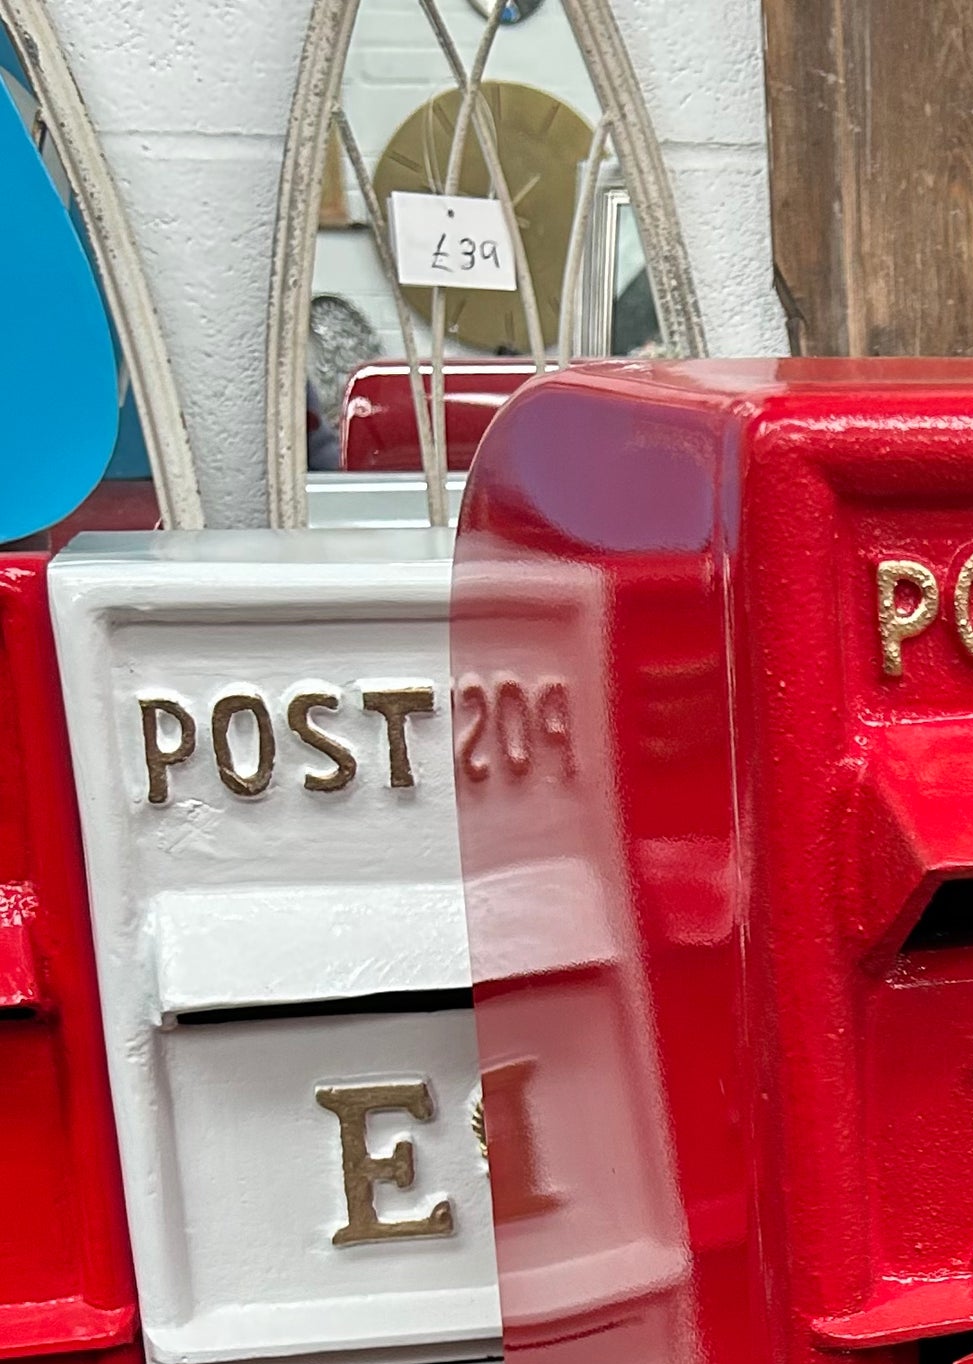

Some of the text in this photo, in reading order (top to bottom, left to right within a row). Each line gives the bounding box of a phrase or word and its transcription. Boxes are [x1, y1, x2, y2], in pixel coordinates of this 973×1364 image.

[431, 233, 501, 273] £39
[137, 687, 434, 803] POST
[315, 1081, 454, 1247] E
